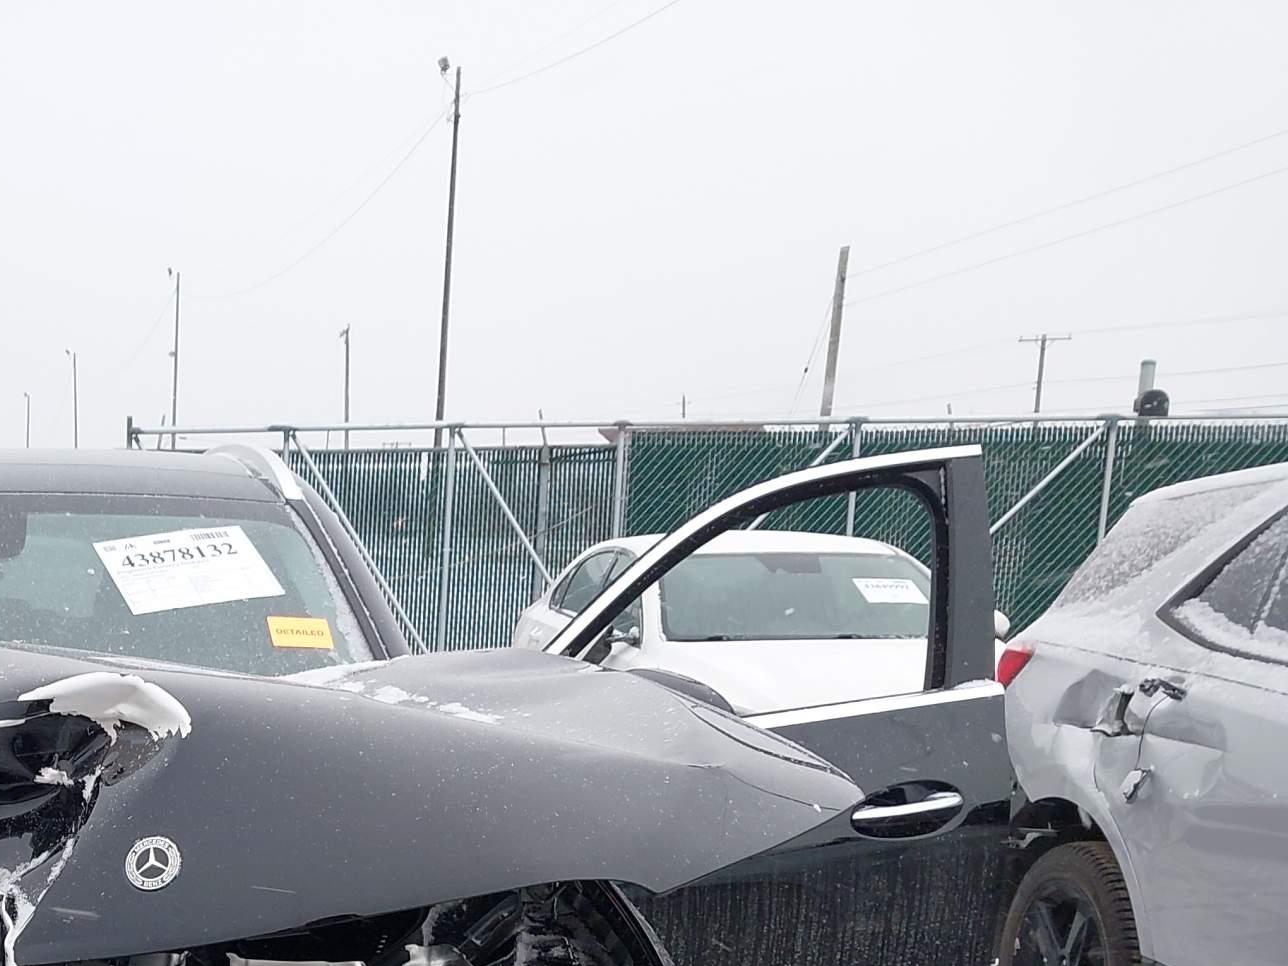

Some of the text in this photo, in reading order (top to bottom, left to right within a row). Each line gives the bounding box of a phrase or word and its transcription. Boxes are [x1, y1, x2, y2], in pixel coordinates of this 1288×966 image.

[122, 542, 238, 568] 43878132
[275, 628, 325, 637] DETAILED
[134, 839, 169, 852] MERCEDES
